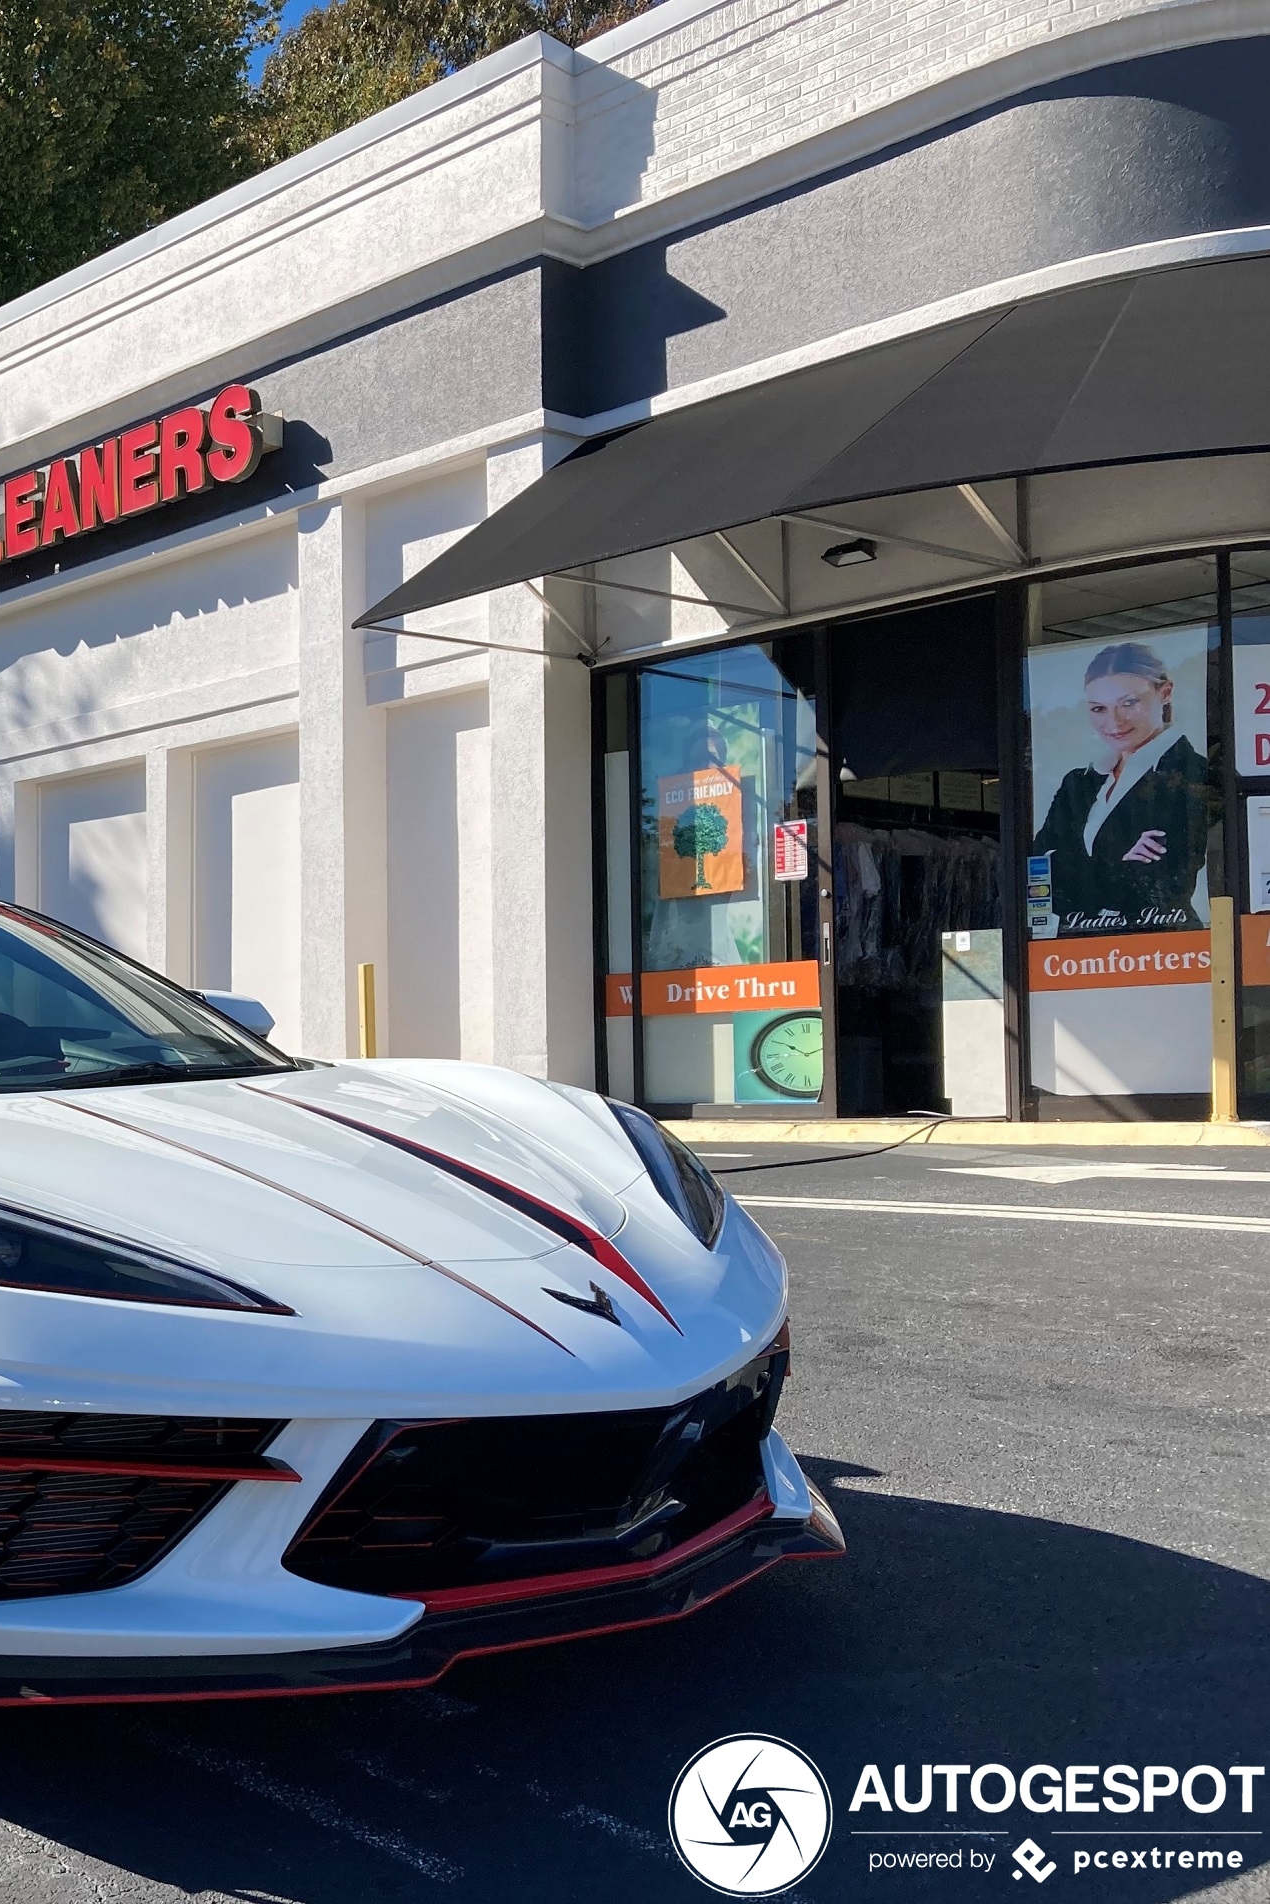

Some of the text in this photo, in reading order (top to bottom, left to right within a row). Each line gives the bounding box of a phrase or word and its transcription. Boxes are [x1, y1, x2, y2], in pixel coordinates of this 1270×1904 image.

[1066, 910, 1128, 929] Ladies
[1136, 906, 1188, 926] Suits
[1043, 948, 1211, 977] Comforters
[666, 976, 797, 1003] Drive Thru
